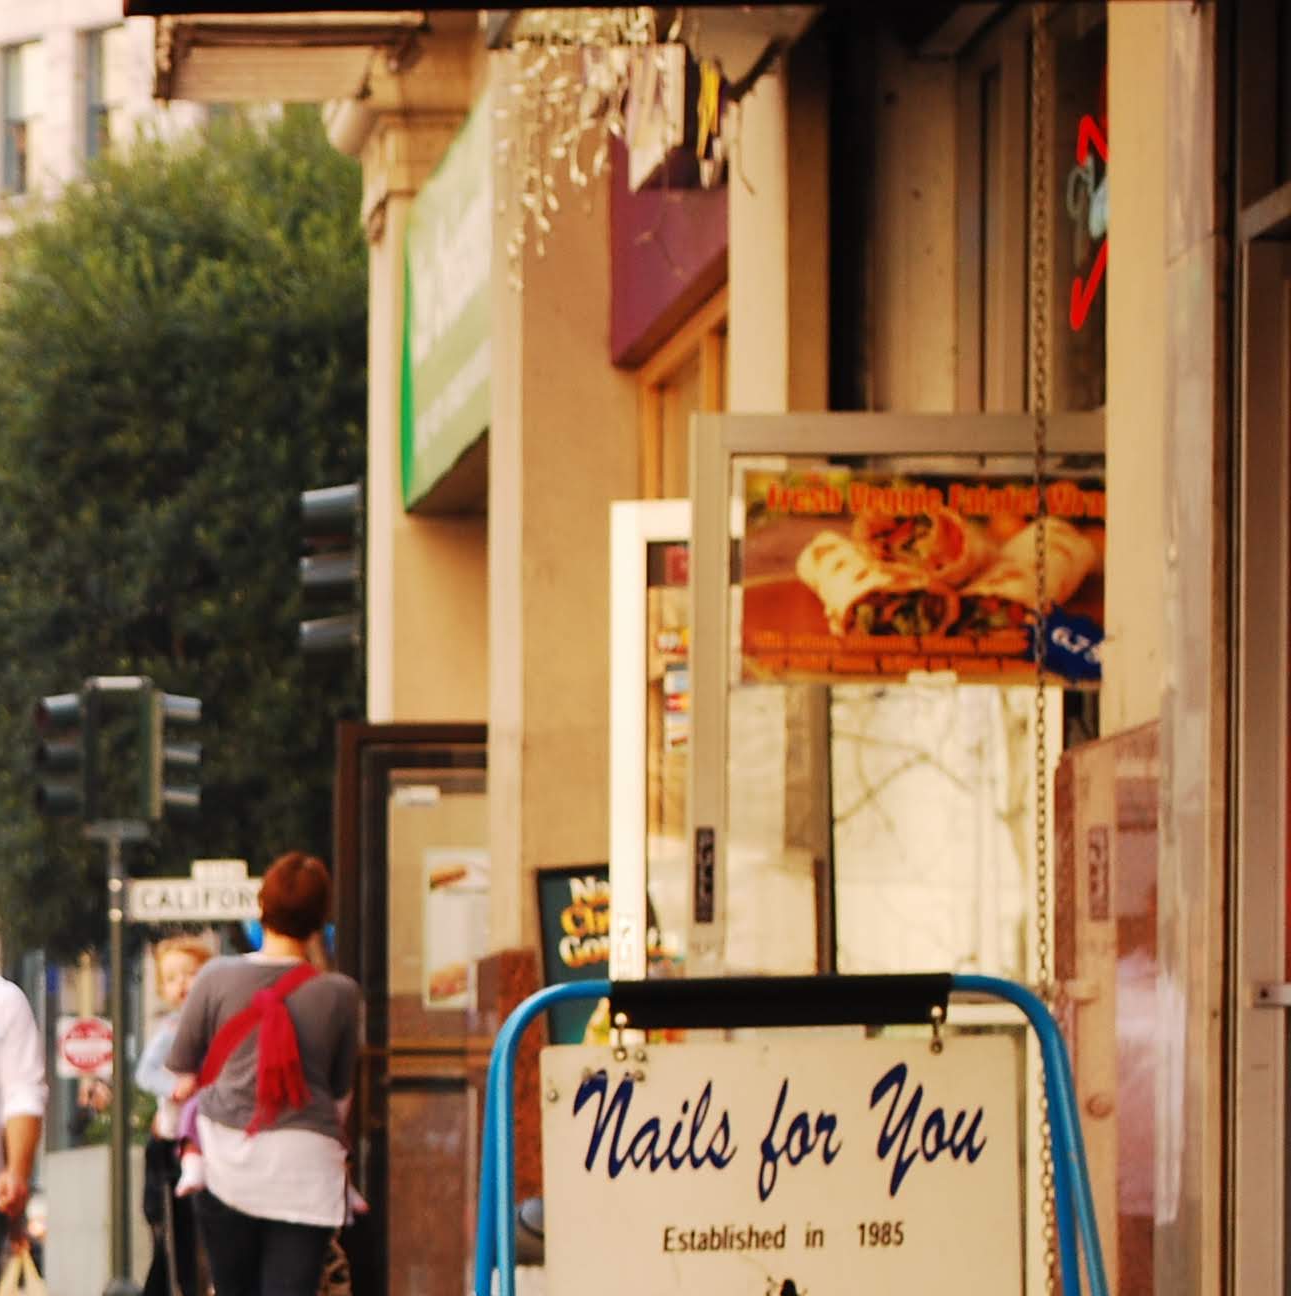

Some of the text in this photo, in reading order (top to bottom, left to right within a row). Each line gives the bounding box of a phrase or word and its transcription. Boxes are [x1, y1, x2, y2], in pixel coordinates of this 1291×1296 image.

[573, 1062, 988, 1203] Nails for You
[663, 1221, 905, 1253] Established in 1985
